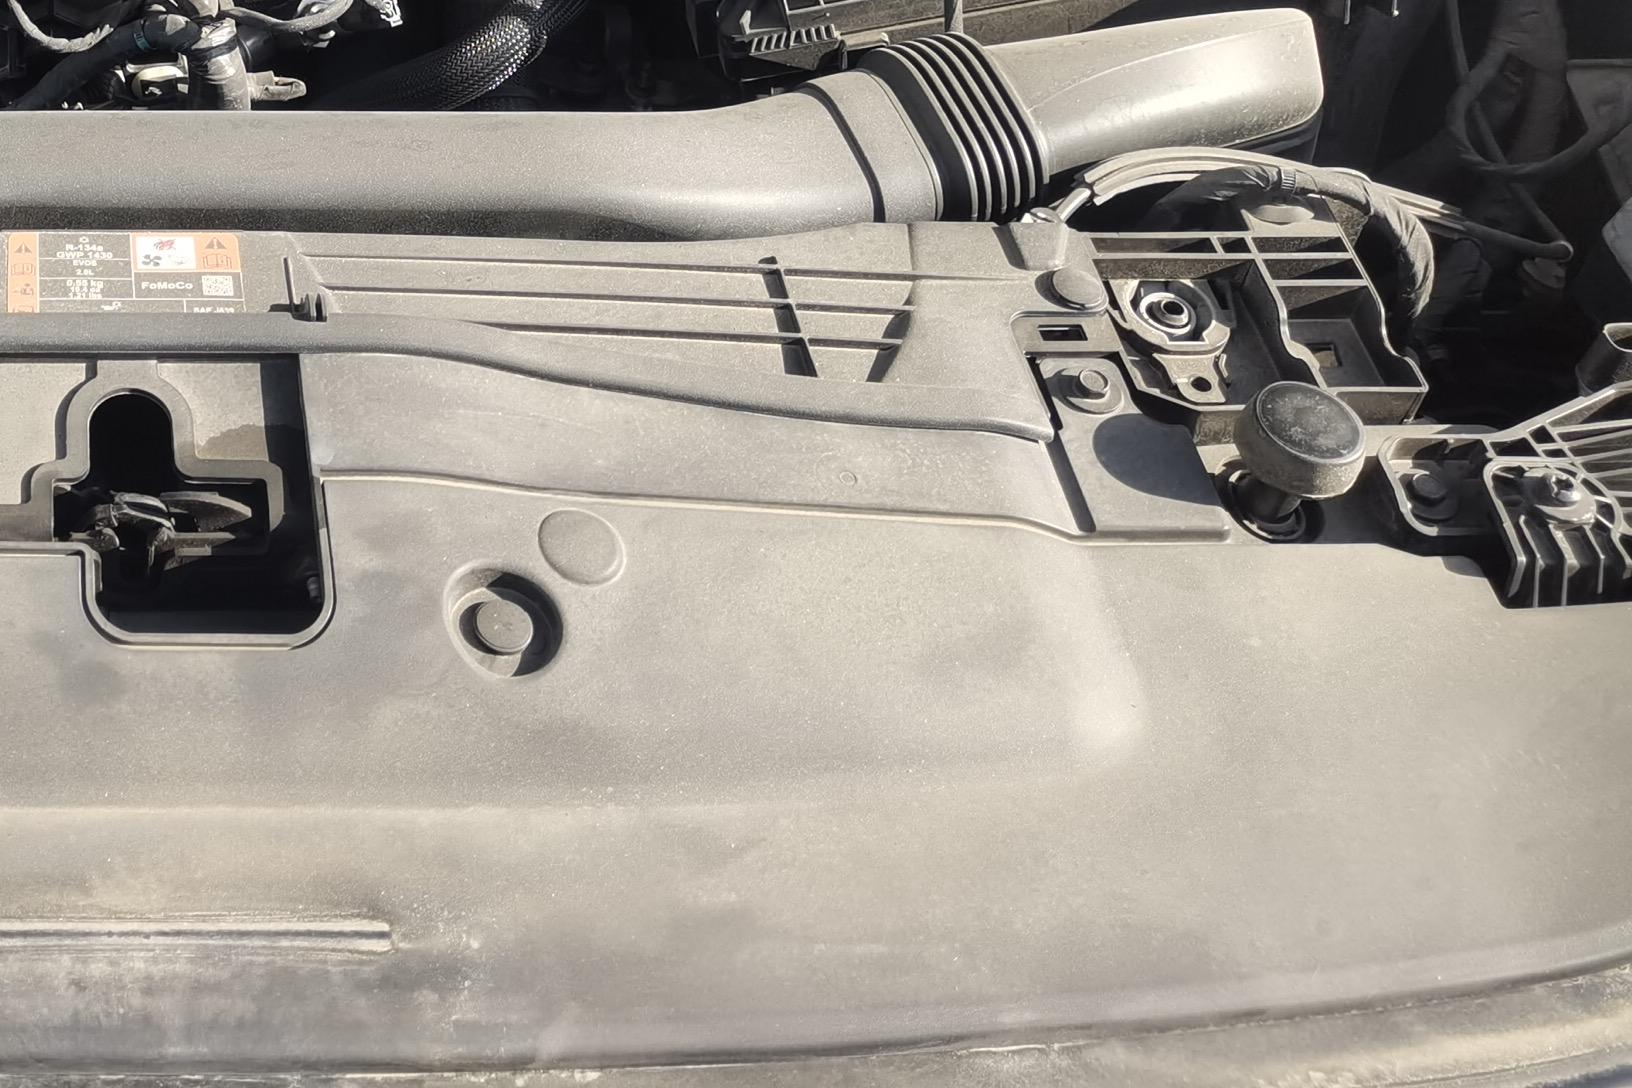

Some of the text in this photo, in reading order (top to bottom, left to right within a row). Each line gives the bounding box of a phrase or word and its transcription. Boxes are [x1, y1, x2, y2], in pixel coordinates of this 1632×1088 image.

[56, 251, 113, 259] GWP 1430
[91, 279, 104, 288] kg
[140, 281, 194, 290] FoMoCo
